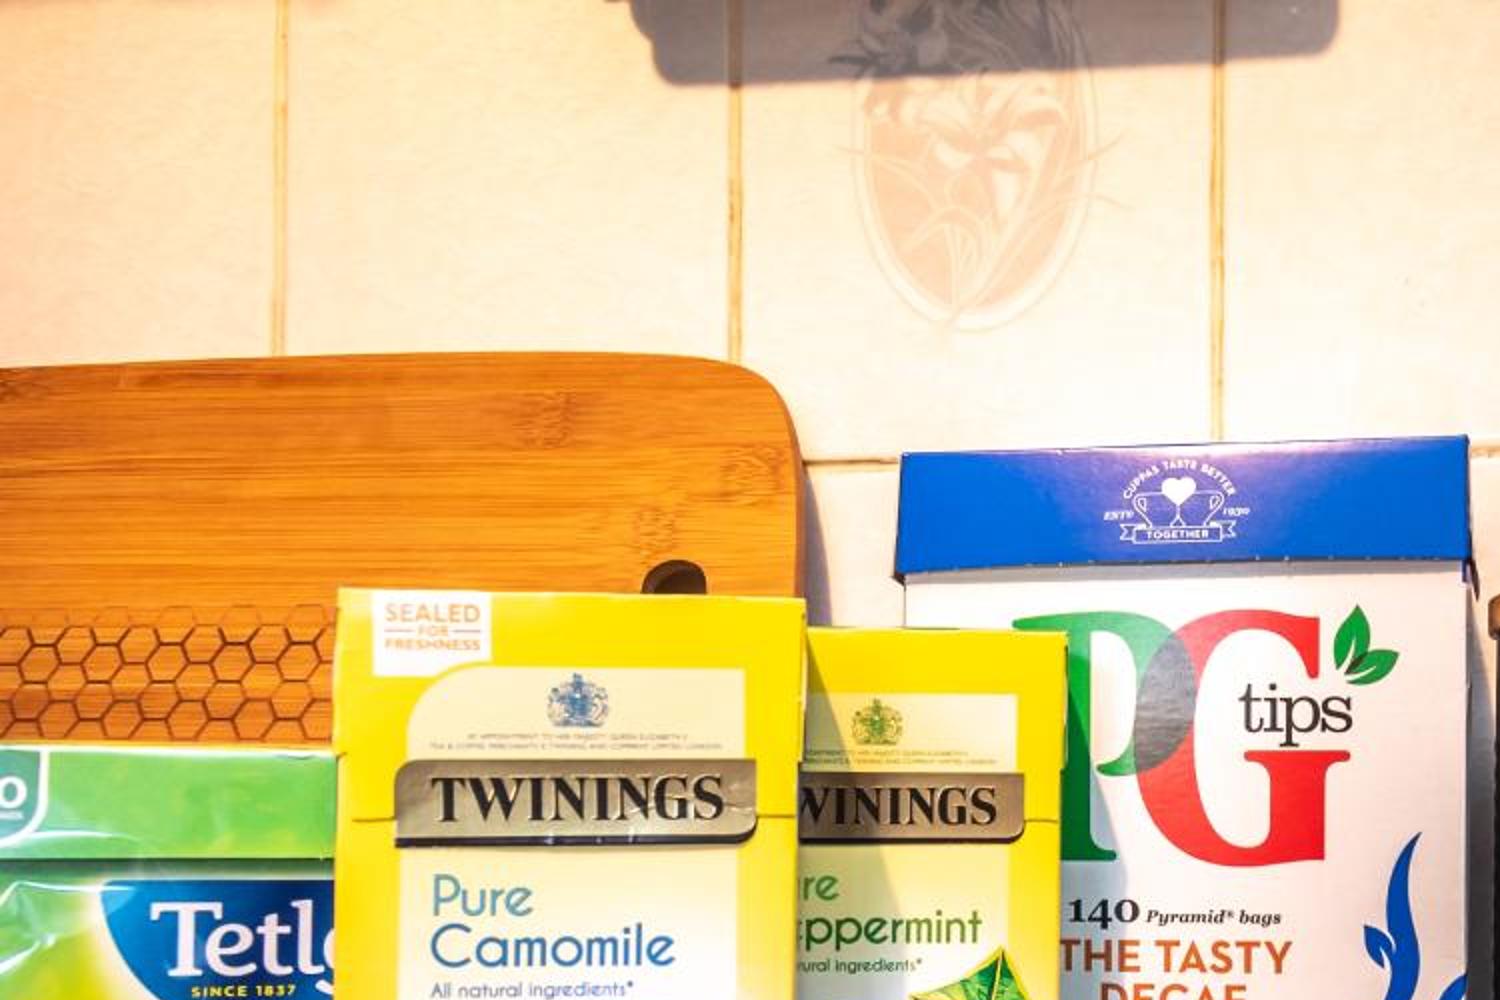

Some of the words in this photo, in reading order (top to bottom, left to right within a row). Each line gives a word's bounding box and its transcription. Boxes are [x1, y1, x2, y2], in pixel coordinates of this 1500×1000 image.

[1146, 530, 1209, 539] TOGETHER
[384, 603, 481, 622] SEALED
[384, 638, 481, 651] FRESHNESS
[1013, 608, 1351, 867] PG
[1238, 683, 1353, 748] tips
[431, 775, 726, 822] TWININGS
[799, 786, 998, 826] WININGS
[433, 874, 534, 917] Pure
[800, 875, 840, 901] re
[800, 909, 983, 951] ppermint
[1068, 898, 1140, 932] 140
[1239, 909, 1282, 927] bags
[150, 898, 333, 994] Tetl
[431, 922, 675, 969] Camomile
[1060, 939, 1141, 973] THE
[1155, 940, 1293, 974] TASTY
[798, 957, 831, 972] ural
[191, 985, 248, 997] SINCE
[255, 984, 297, 996] 1837
[431, 982, 452, 998] All
[458, 981, 523, 998] natural
